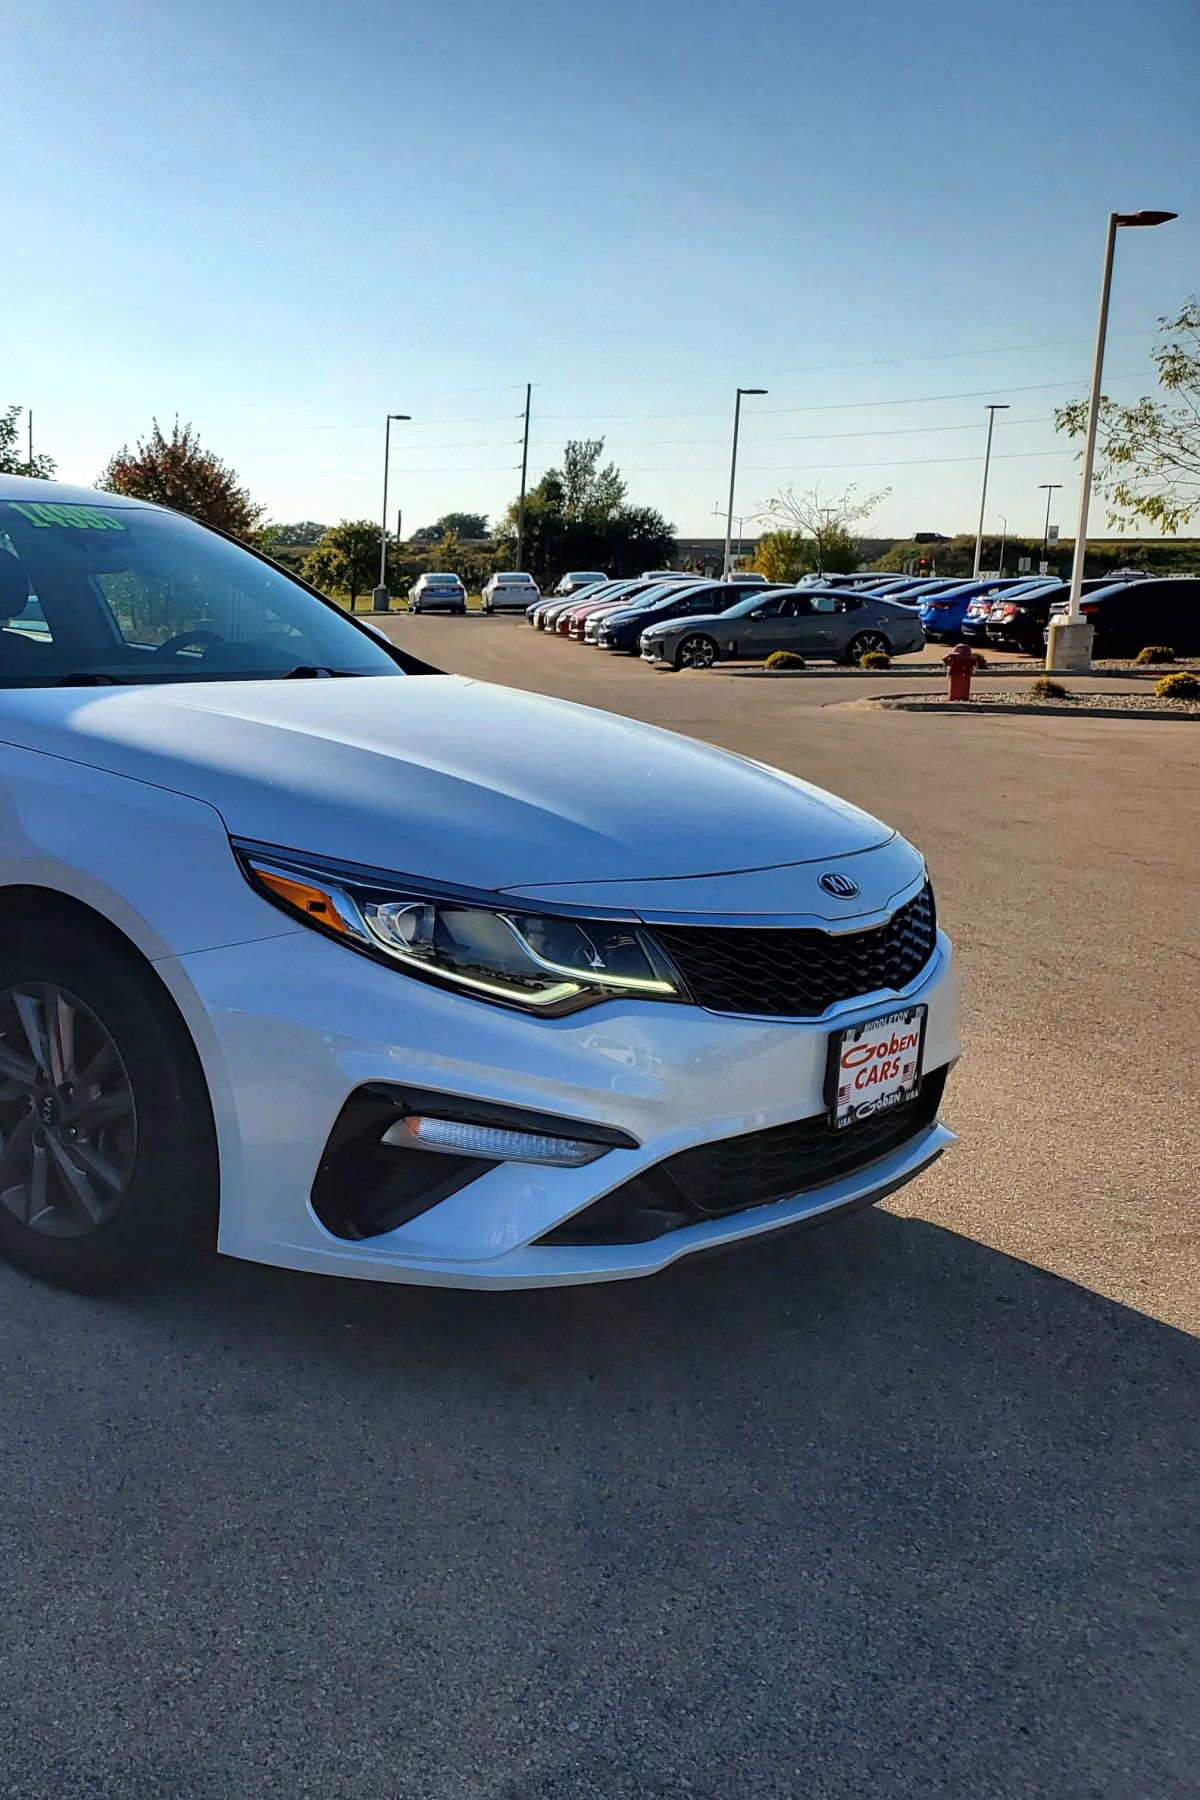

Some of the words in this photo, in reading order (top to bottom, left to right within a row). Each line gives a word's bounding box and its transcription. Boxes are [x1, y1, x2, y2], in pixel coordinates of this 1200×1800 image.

[823, 874, 858, 892] KIA
[863, 1010, 910, 1032] MIDDLETON
[854, 1056, 902, 1089] CARS
[905, 1088, 919, 1101] USA
